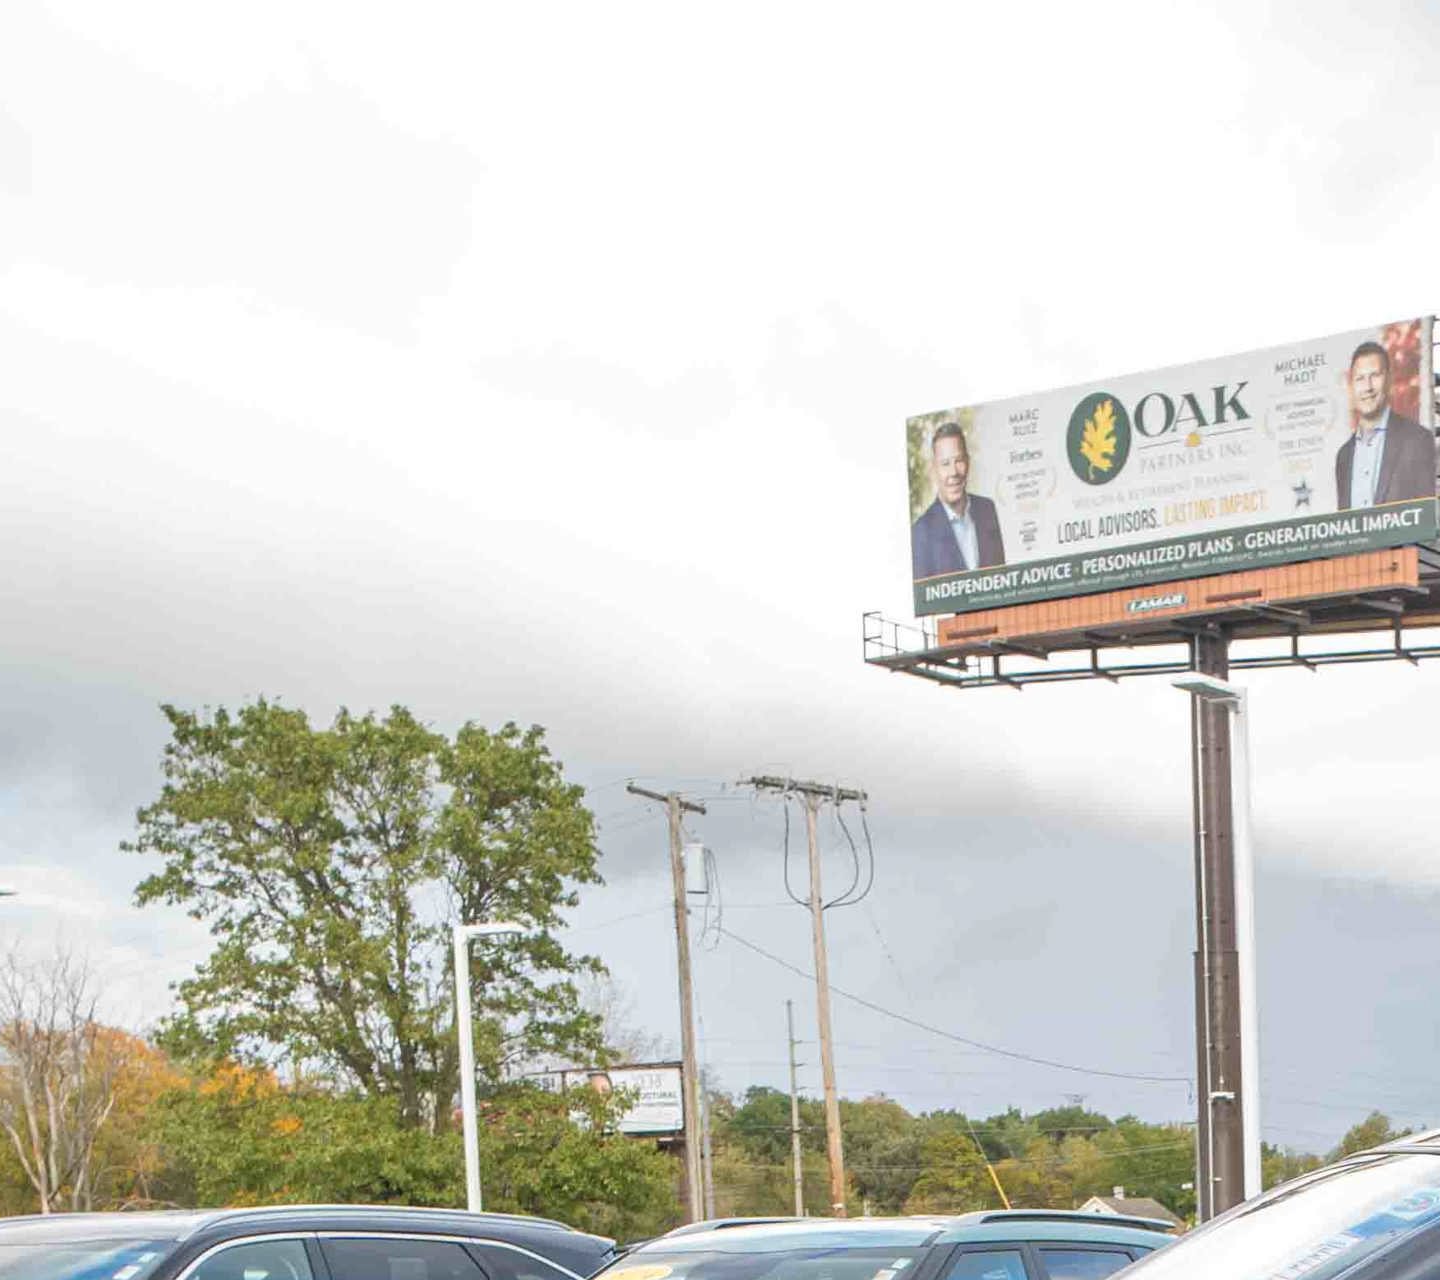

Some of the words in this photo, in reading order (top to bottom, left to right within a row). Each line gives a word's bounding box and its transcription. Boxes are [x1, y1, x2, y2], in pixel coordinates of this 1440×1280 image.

[1275, 354, 1328, 373] MICHAEL
[1134, 381, 1251, 438] OAK
[1140, 447, 1215, 474] PARTNERS
[1058, 522, 1094, 544] LOCAL
[1098, 508, 1160, 538] ADVISORS.
[1164, 497, 1216, 526] LASTING
[925, 571, 1019, 601] INDEPENDENT
[1021, 563, 1072, 587] ADVICE
[1082, 543, 1185, 576] PERSONALIZED
[1188, 536, 1234, 559] PLANS
[1244, 520, 1360, 549] GENERATIONAL
[1363, 508, 1423, 532] IMPACT
